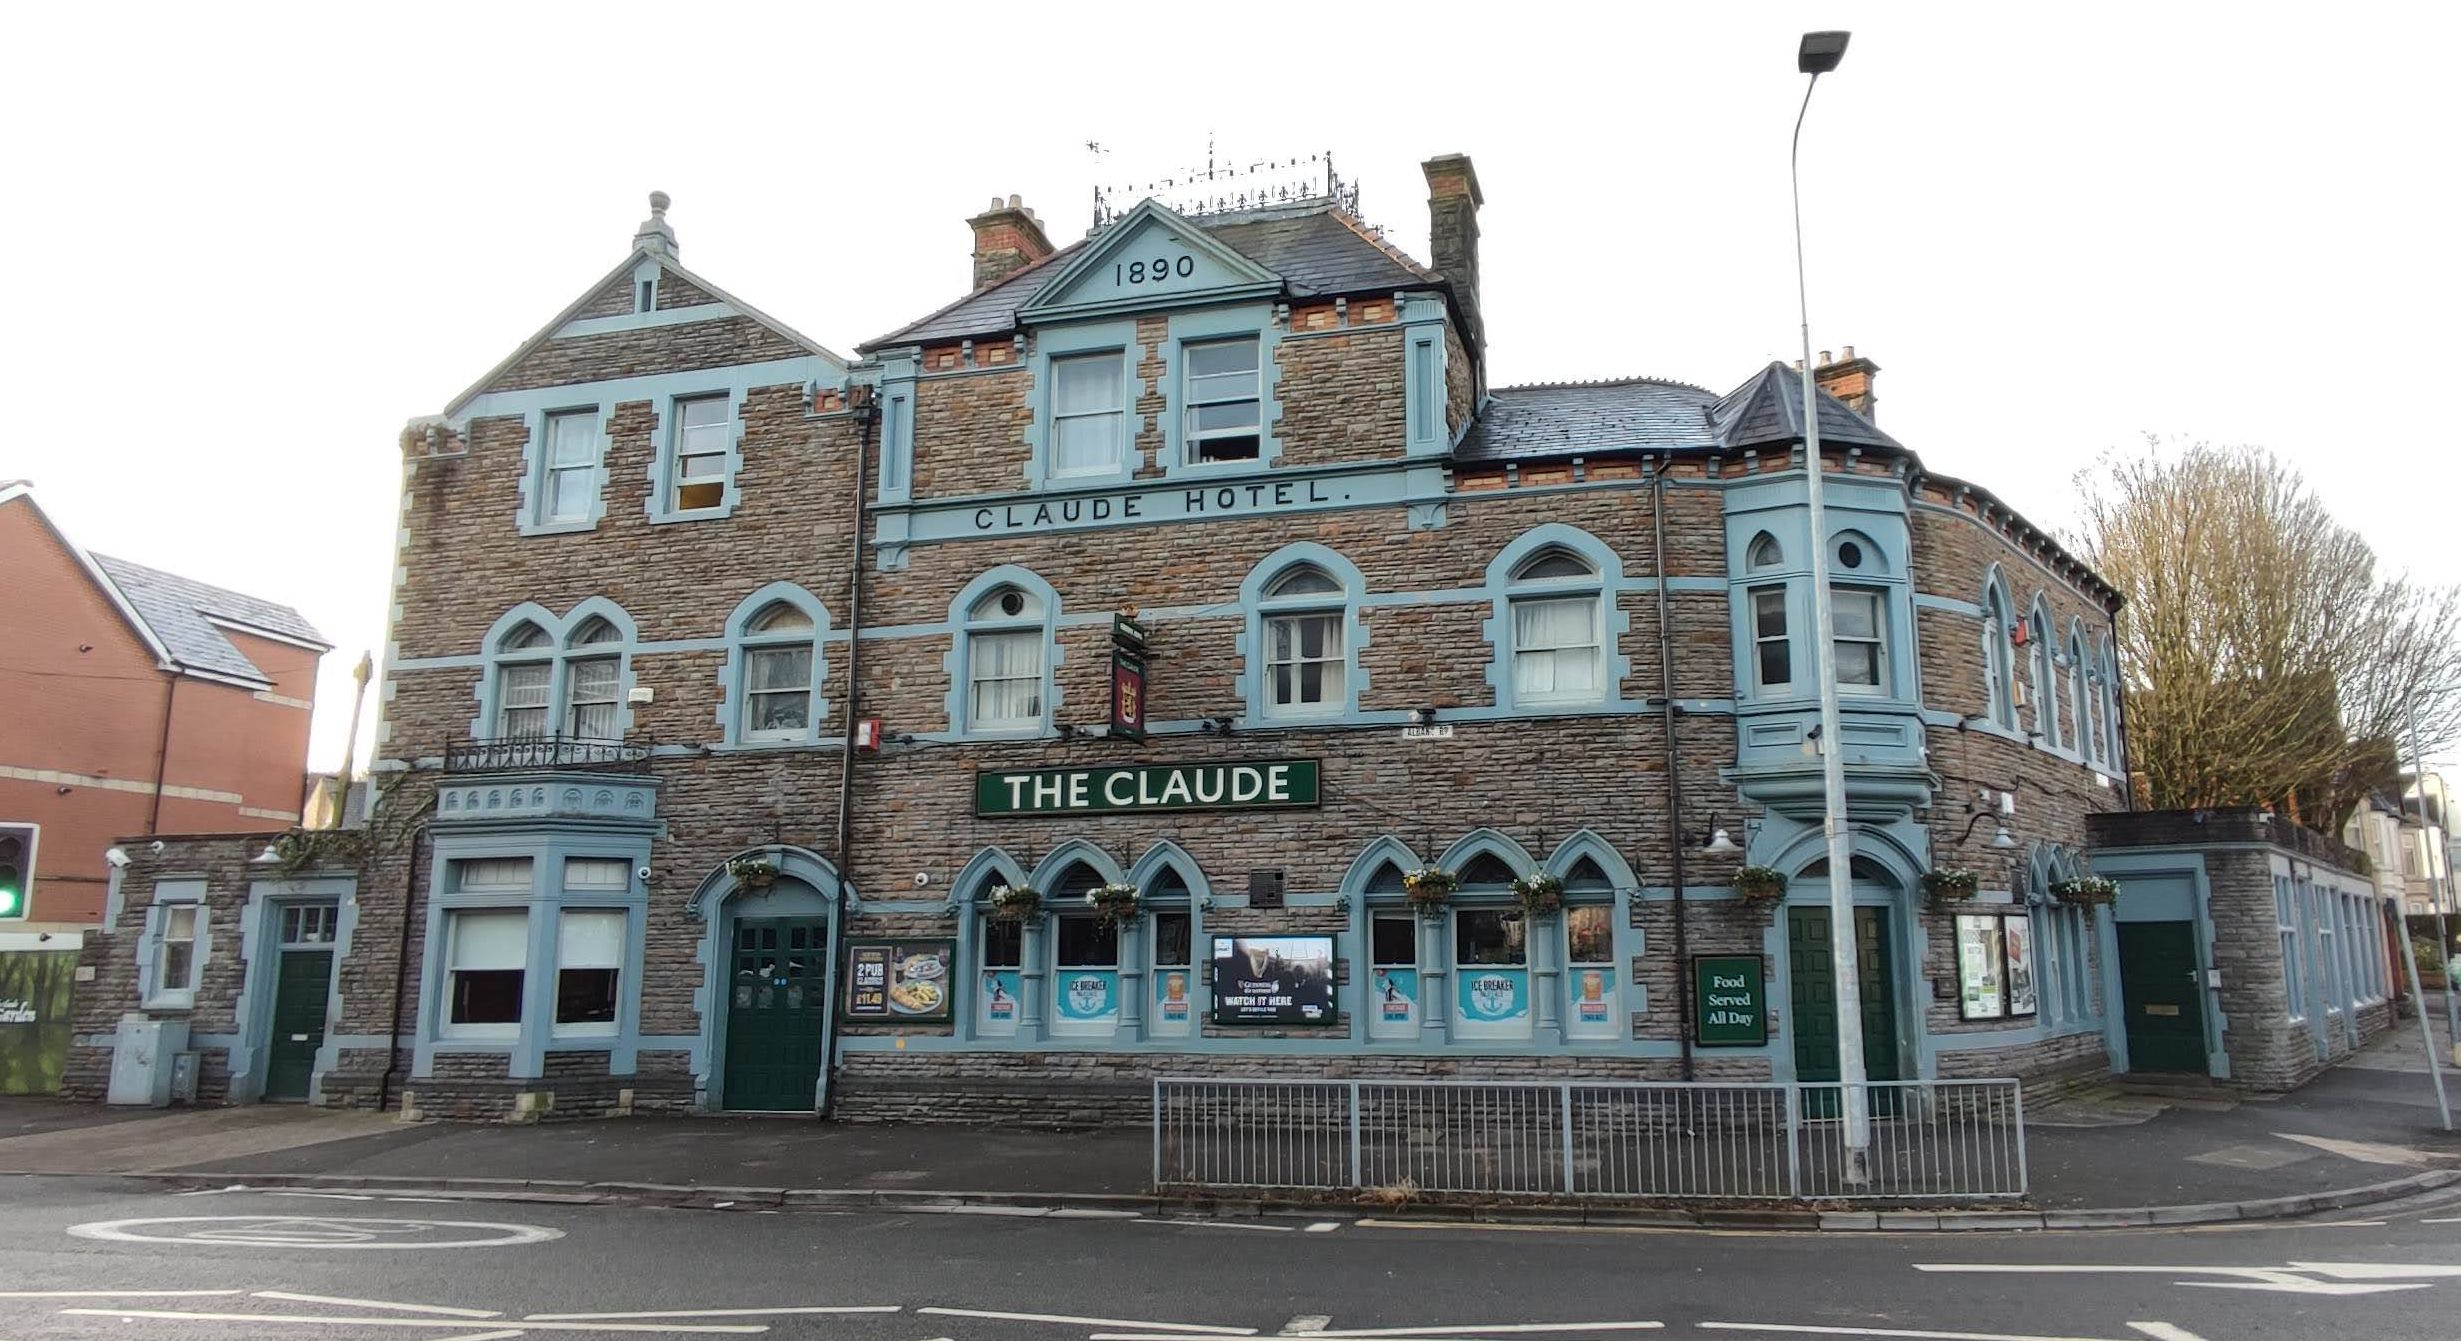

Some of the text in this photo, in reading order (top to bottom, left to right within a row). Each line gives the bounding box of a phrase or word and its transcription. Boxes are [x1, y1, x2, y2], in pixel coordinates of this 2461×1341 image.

[1116, 255, 1194, 287] 1890
[975, 481, 1351, 530] CLAUDE HOTEL.
[1003, 765, 1291, 810] THE CLAUDE
[857, 962, 884, 977] 2 PUB
[1471, 979, 1514, 991] ICE BREAKER
[1713, 974, 1746, 988] Food
[1225, 996, 1293, 1006] WATCH IT HERE
[1708, 992, 1751, 1006] Served
[1708, 1010, 1754, 1027] All Day
